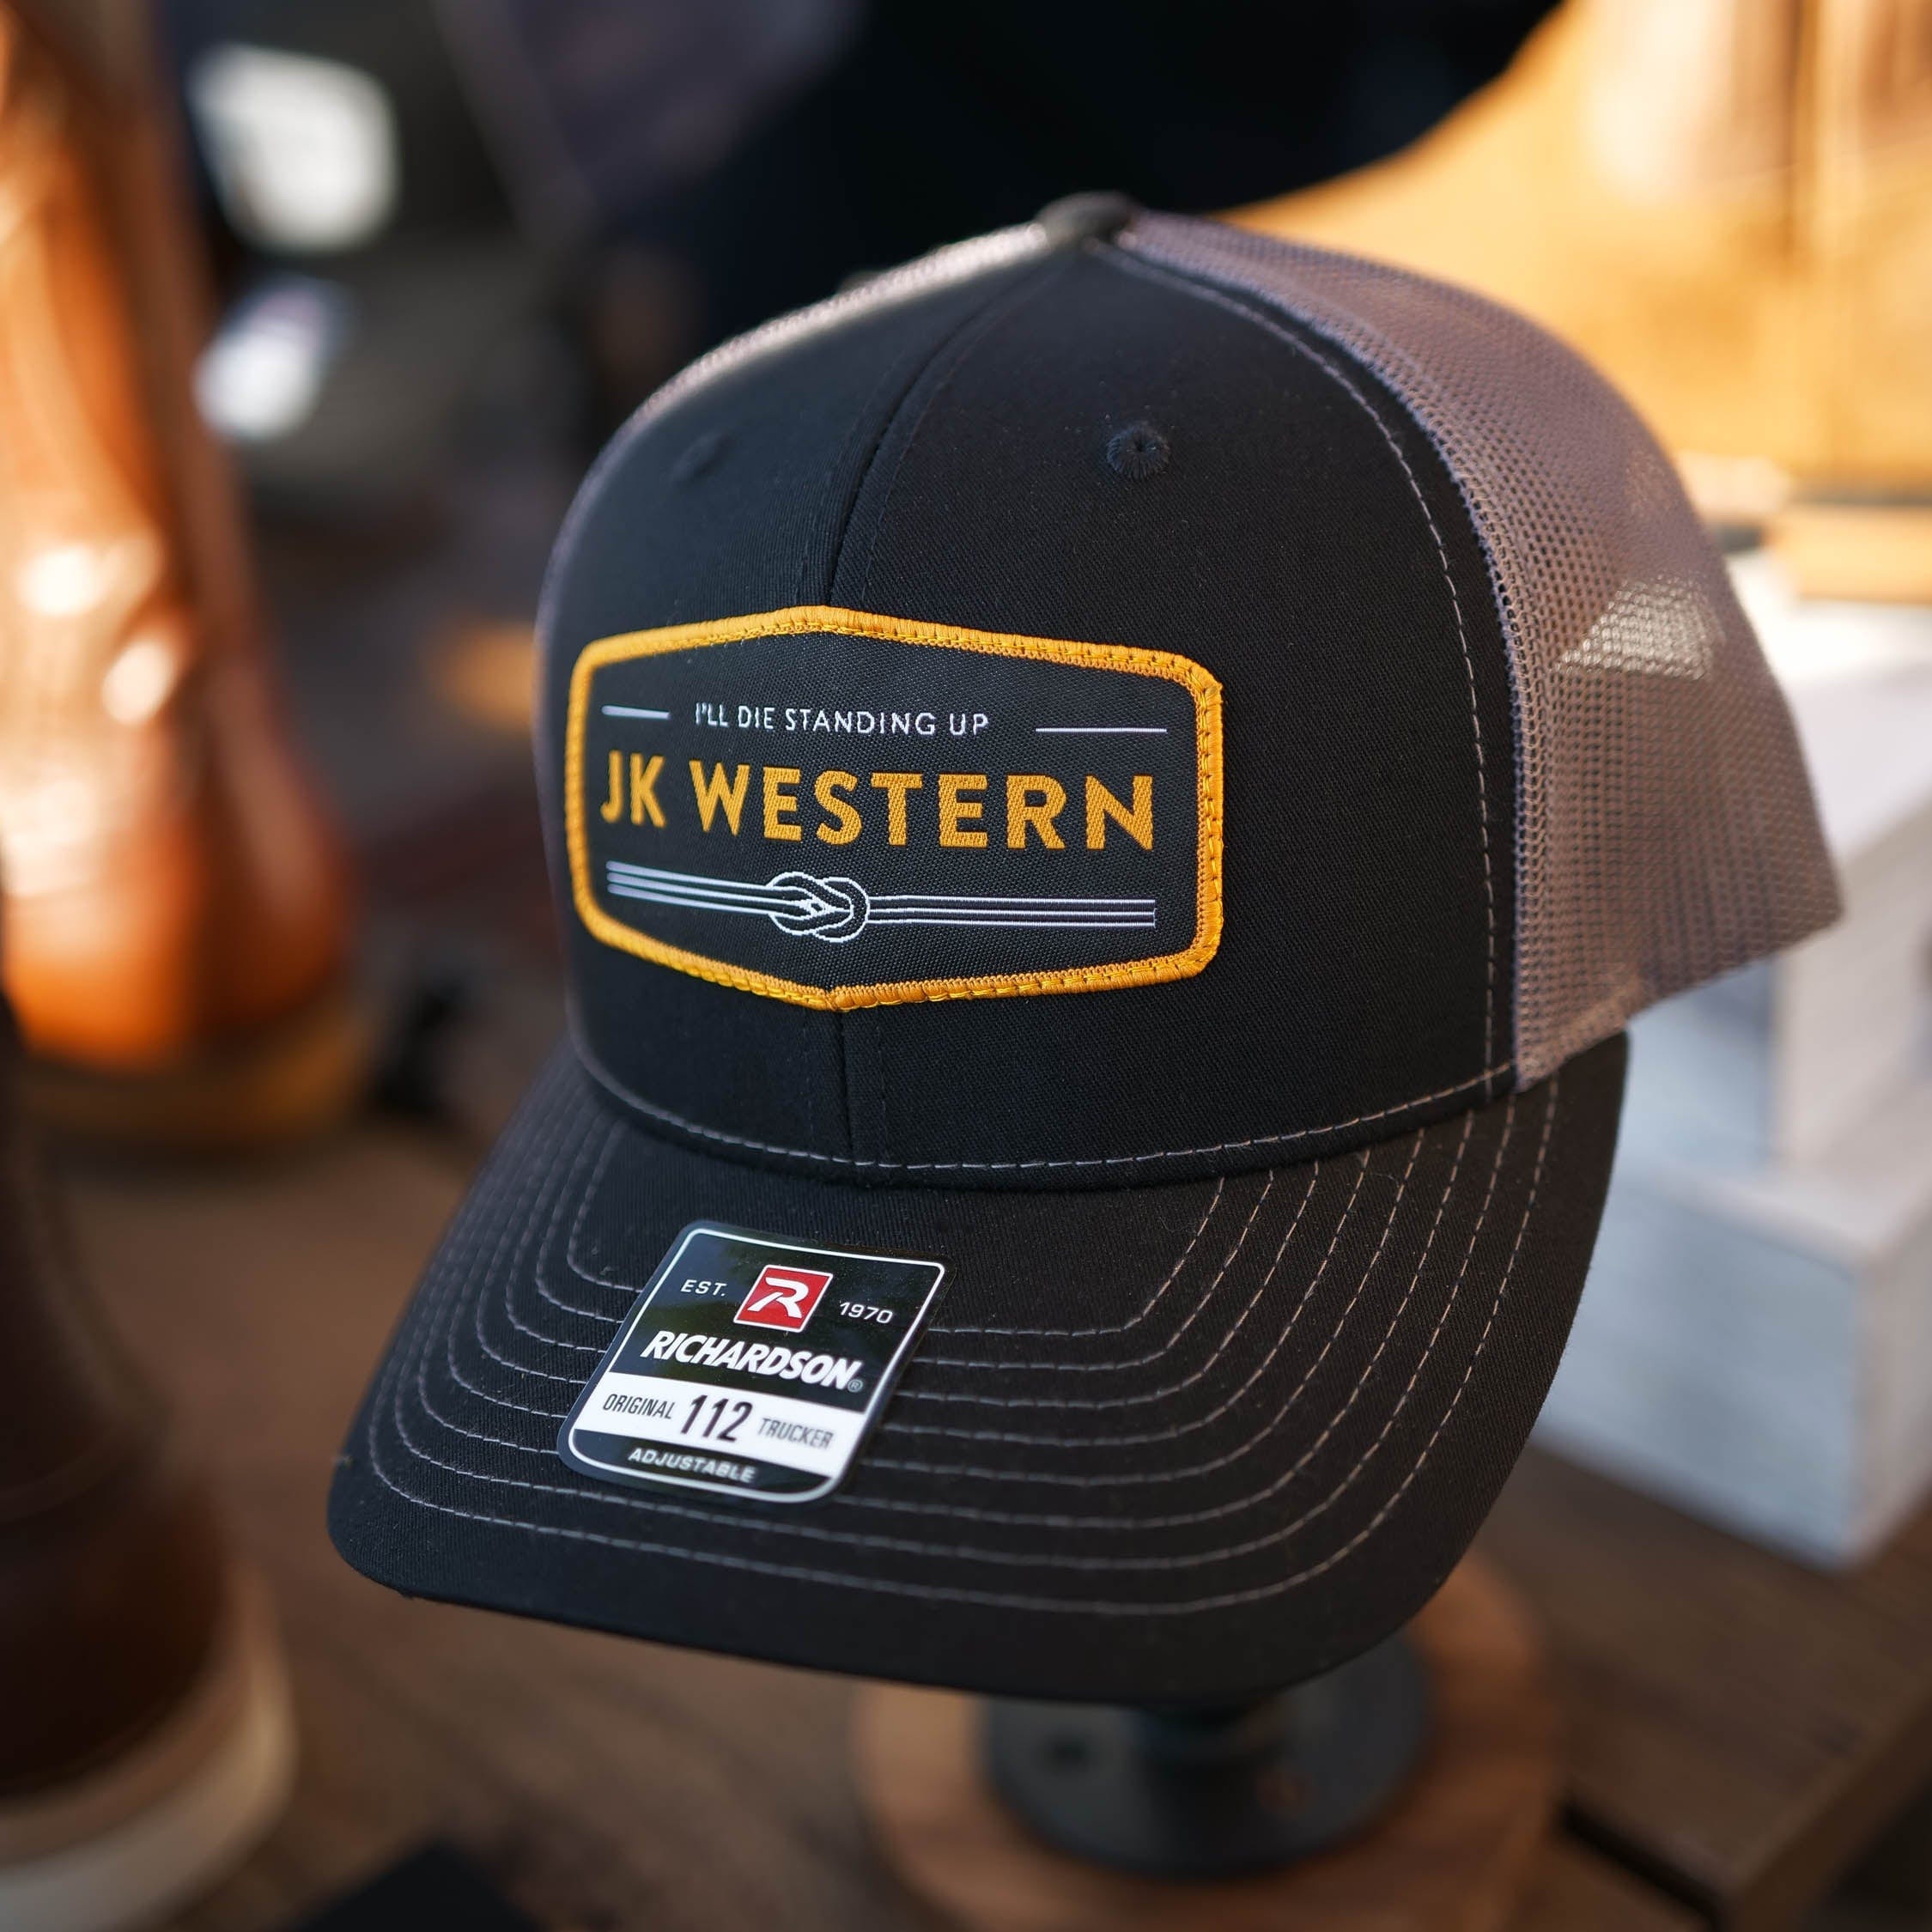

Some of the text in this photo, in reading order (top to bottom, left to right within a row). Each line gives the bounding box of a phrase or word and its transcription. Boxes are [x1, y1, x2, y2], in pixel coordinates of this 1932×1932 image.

[694, 701, 989, 737] I'LL DIE STANDING UP
[601, 750, 1155, 852] JK WESTERN
[680, 1278, 727, 1297] EST.
[838, 1300, 894, 1325] 1970
[602, 1392, 835, 1449] ORIGINAL 112 TRUCKER
[627, 1446, 757, 1485] ADJUSTABLE
